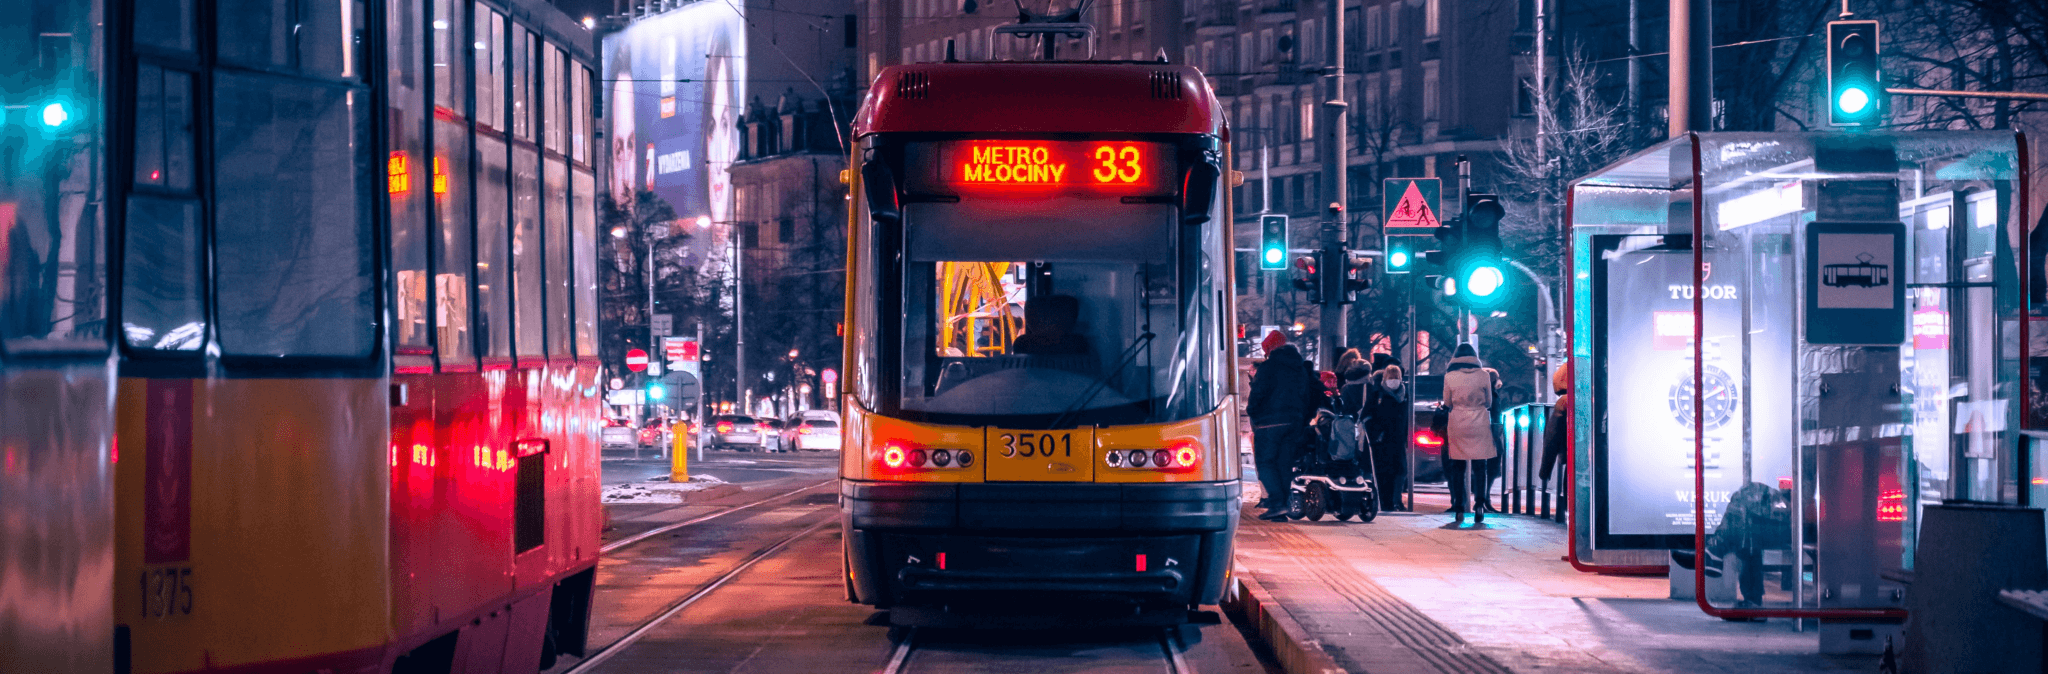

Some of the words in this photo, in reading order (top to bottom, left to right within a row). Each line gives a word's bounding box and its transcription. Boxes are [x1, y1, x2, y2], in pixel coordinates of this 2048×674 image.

[973, 146, 1049, 164] METRO
[1093, 146, 1142, 182] 33
[964, 163, 1065, 182] MŁOCINY
[1668, 284, 1737, 299] TUDOR
[1000, 433, 1070, 458] 3501
[140, 567, 193, 618] 1375
